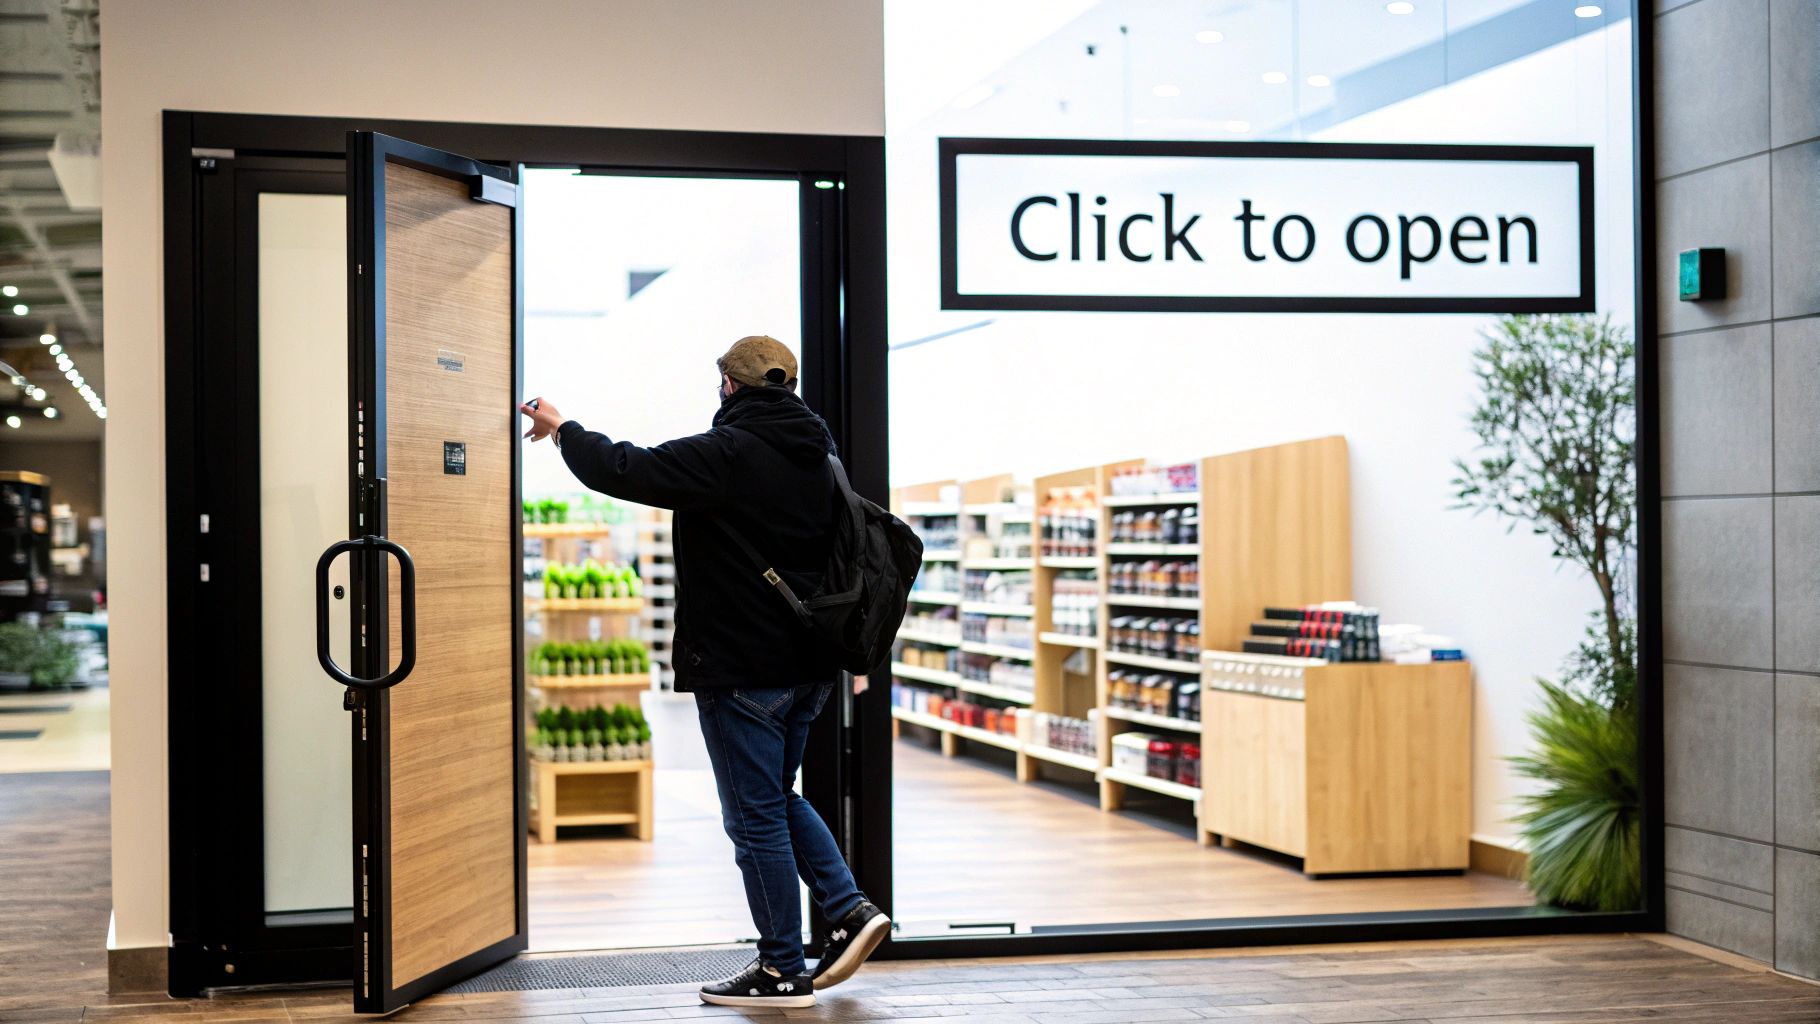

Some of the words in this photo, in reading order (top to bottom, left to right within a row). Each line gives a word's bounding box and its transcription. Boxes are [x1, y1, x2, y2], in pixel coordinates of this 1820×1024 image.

[1010, 192, 1203, 262] Click
[1234, 199, 1315, 262] to
[1345, 214, 1538, 281] open
